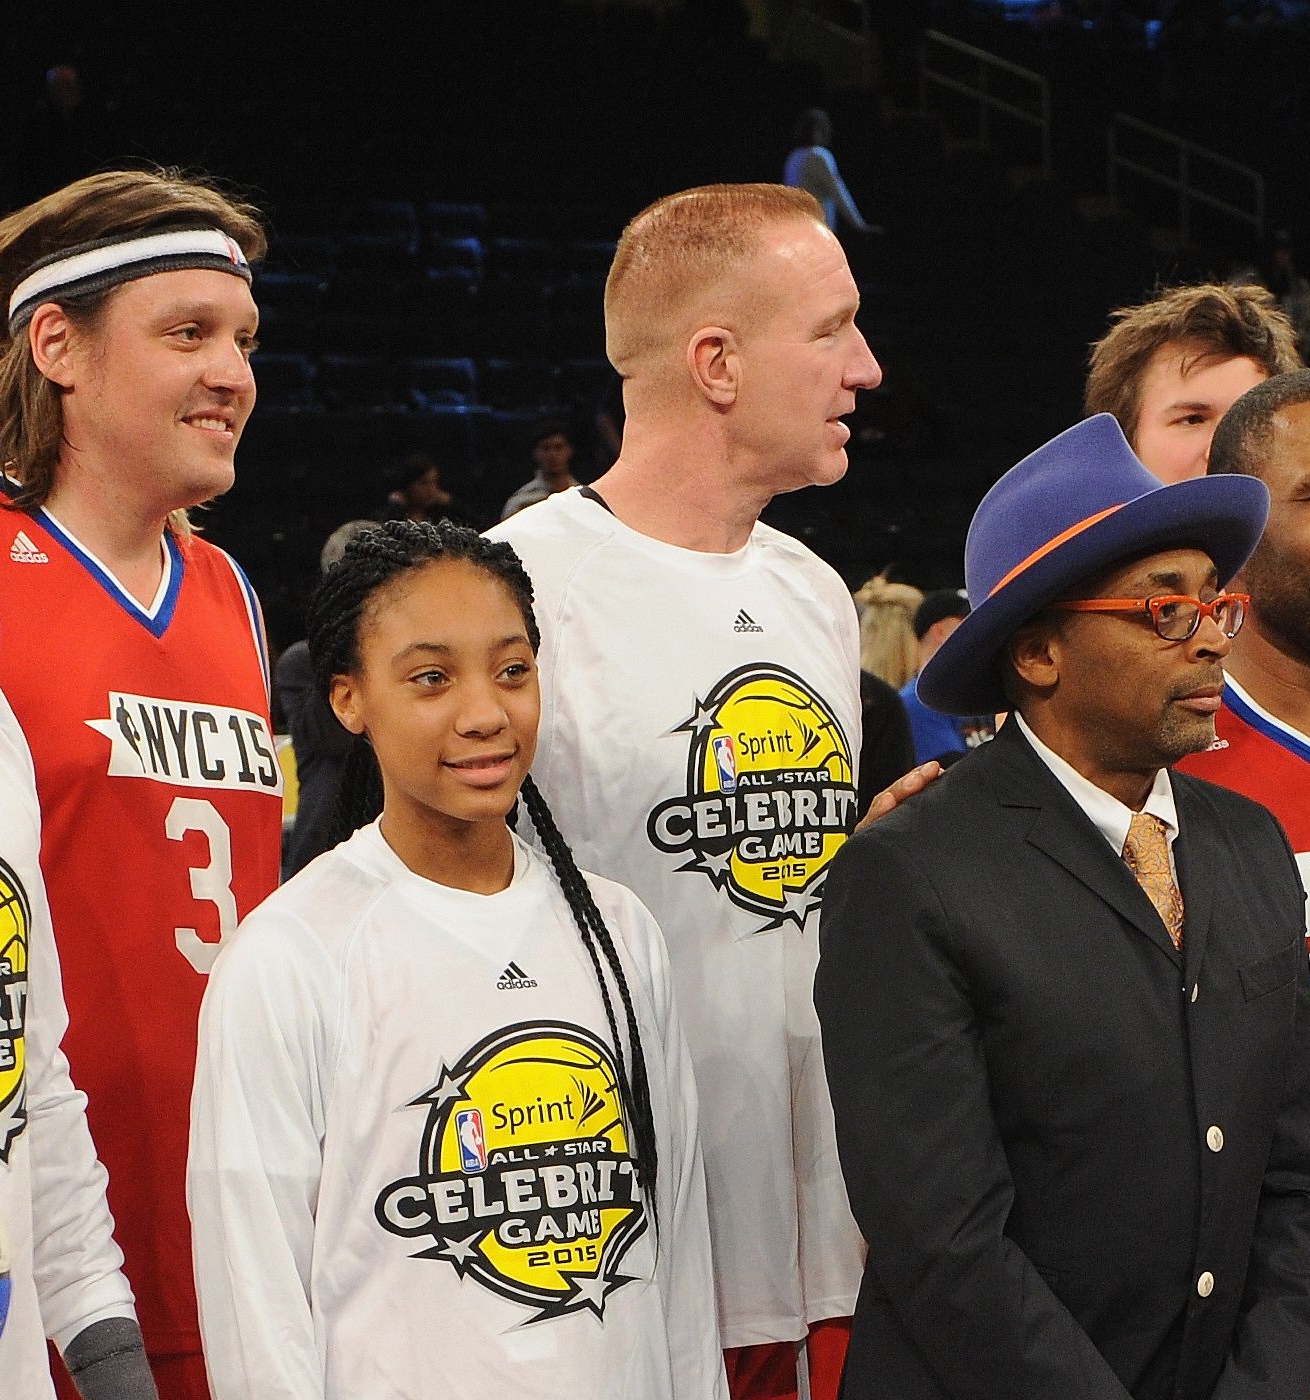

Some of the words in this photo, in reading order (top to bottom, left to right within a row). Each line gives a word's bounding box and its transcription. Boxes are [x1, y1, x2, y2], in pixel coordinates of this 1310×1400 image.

[9, 552, 49, 564] adidas
[733, 621, 764, 633] adidas
[137, 703, 225, 781] NYC
[228, 715, 278, 788] 15
[738, 729, 795, 763] Sprint
[738, 773, 773, 787] ALL
[784, 770, 830, 784] STAR
[654, 788, 858, 846] CELEBRIT
[739, 831, 821, 861] GAME
[165, 797, 238, 975] 3
[496, 977, 538, 991] adidas
[491, 1094, 576, 1136] Sprint
[491, 1151, 540, 1166] ALL
[564, 1140, 608, 1156] STAR
[497, 1208, 601, 1245] GAME
[527, 1245, 598, 1268] 2015
